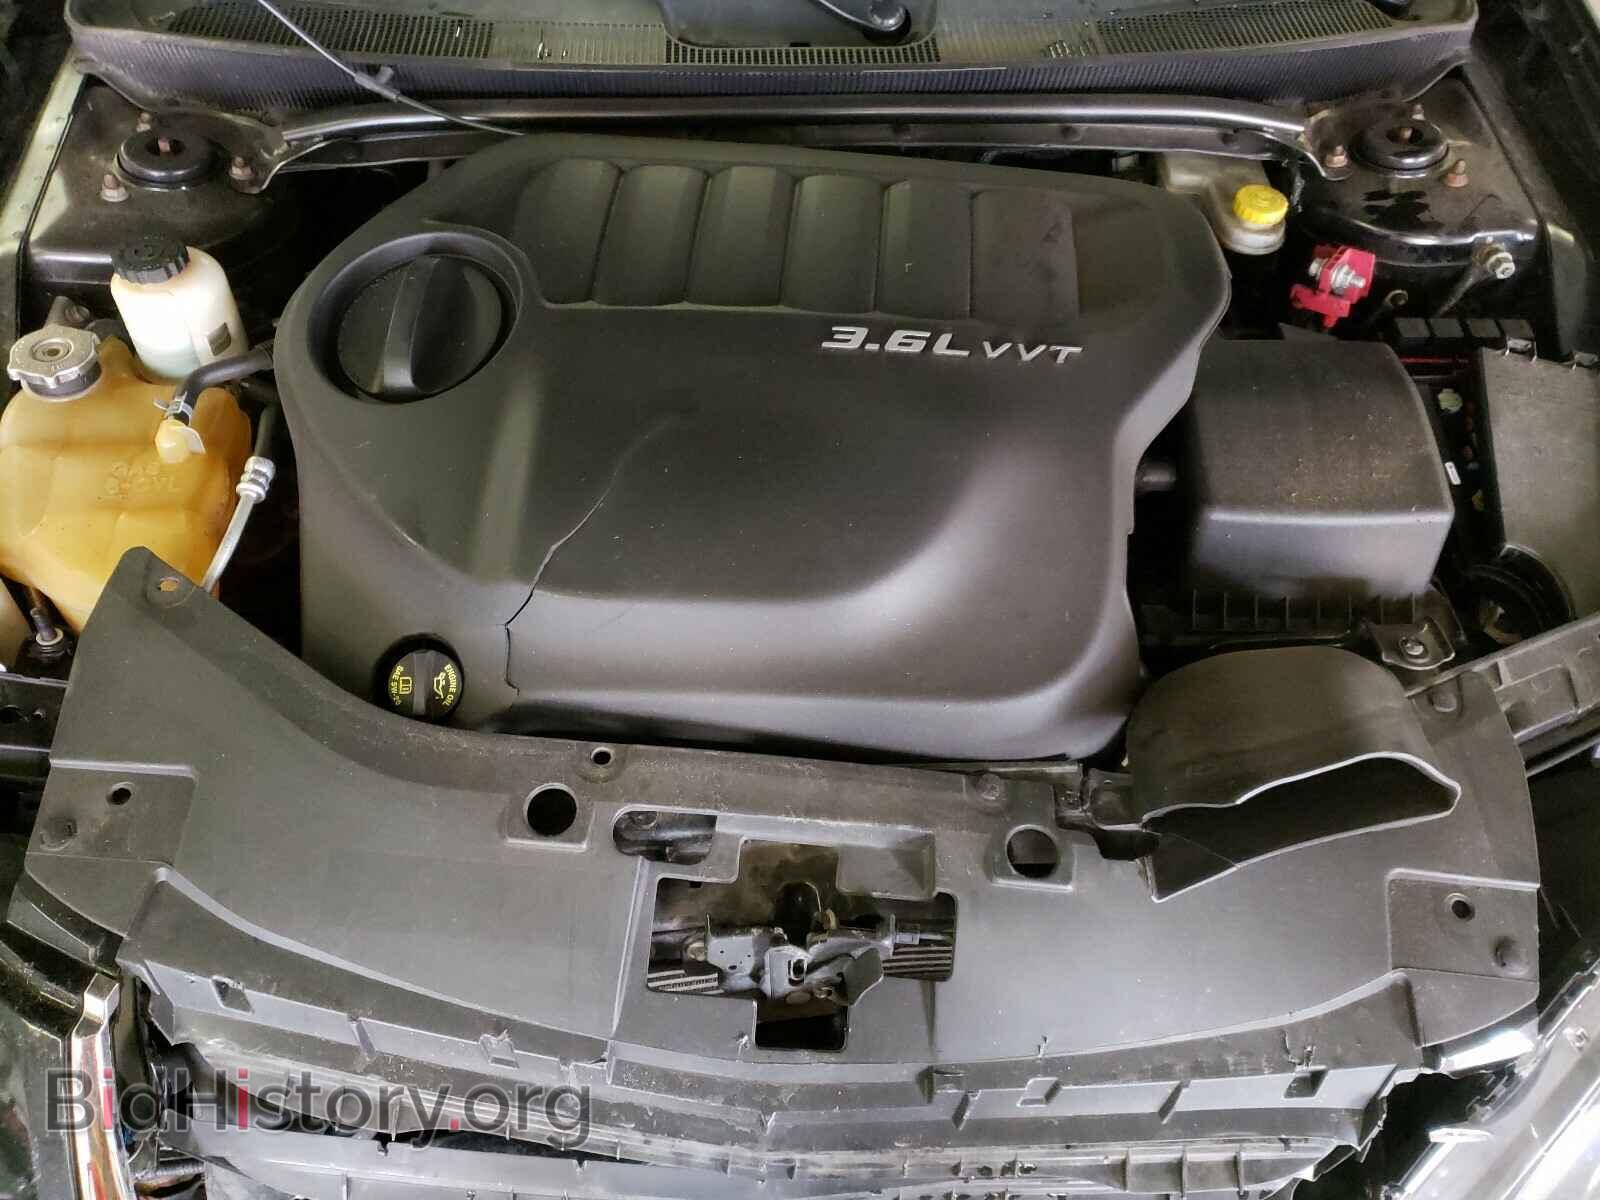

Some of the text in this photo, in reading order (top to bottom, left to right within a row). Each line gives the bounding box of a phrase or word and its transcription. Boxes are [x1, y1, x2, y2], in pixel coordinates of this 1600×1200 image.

[821, 326, 1083, 364] 3.6L VVT
[442, 663, 457, 706] ENGINE OIL
